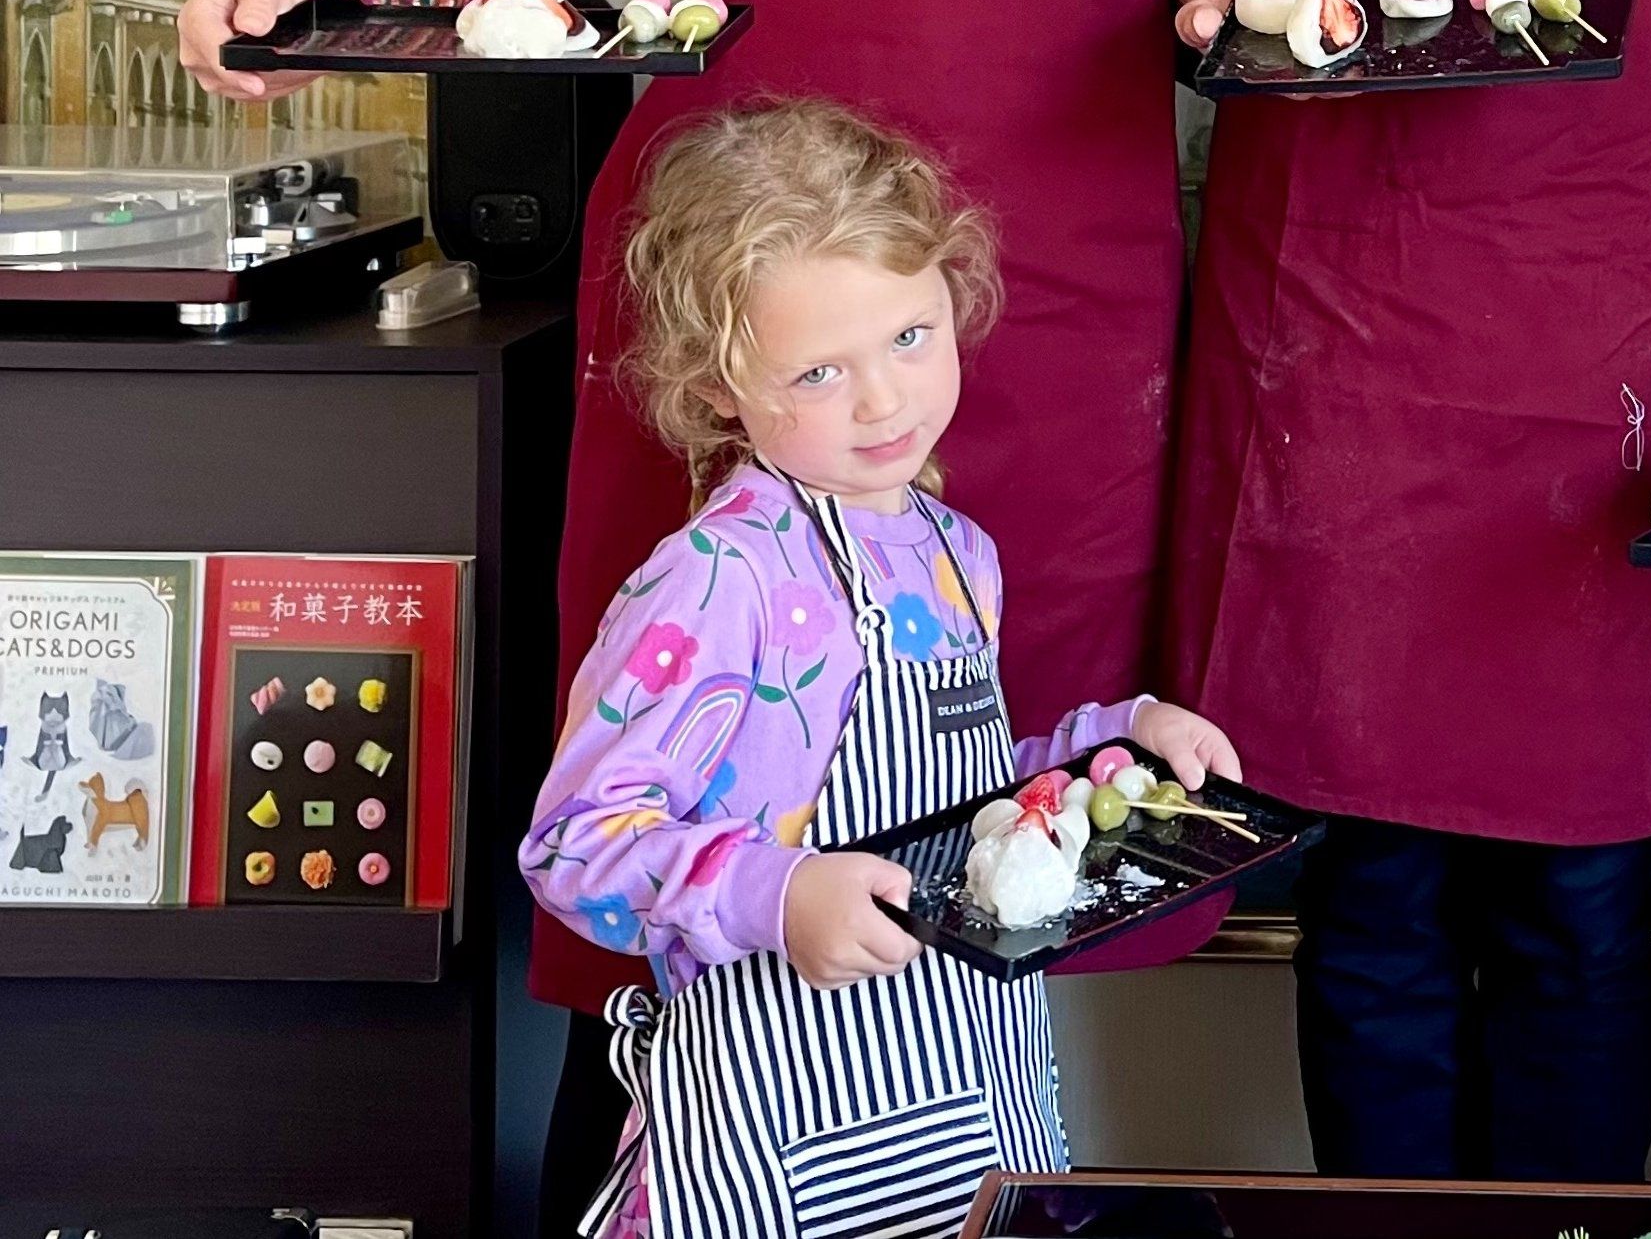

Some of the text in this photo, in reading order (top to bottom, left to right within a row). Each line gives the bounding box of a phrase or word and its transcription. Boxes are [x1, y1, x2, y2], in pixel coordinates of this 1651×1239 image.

[269, 592, 424, 627] 和菓子教本
[9, 610, 118, 631] ORIGAMI
[34, 666, 88, 676] PREMIUM
[937, 703, 964, 717] DEAN
[67, 888, 131, 899] MAKOTO
